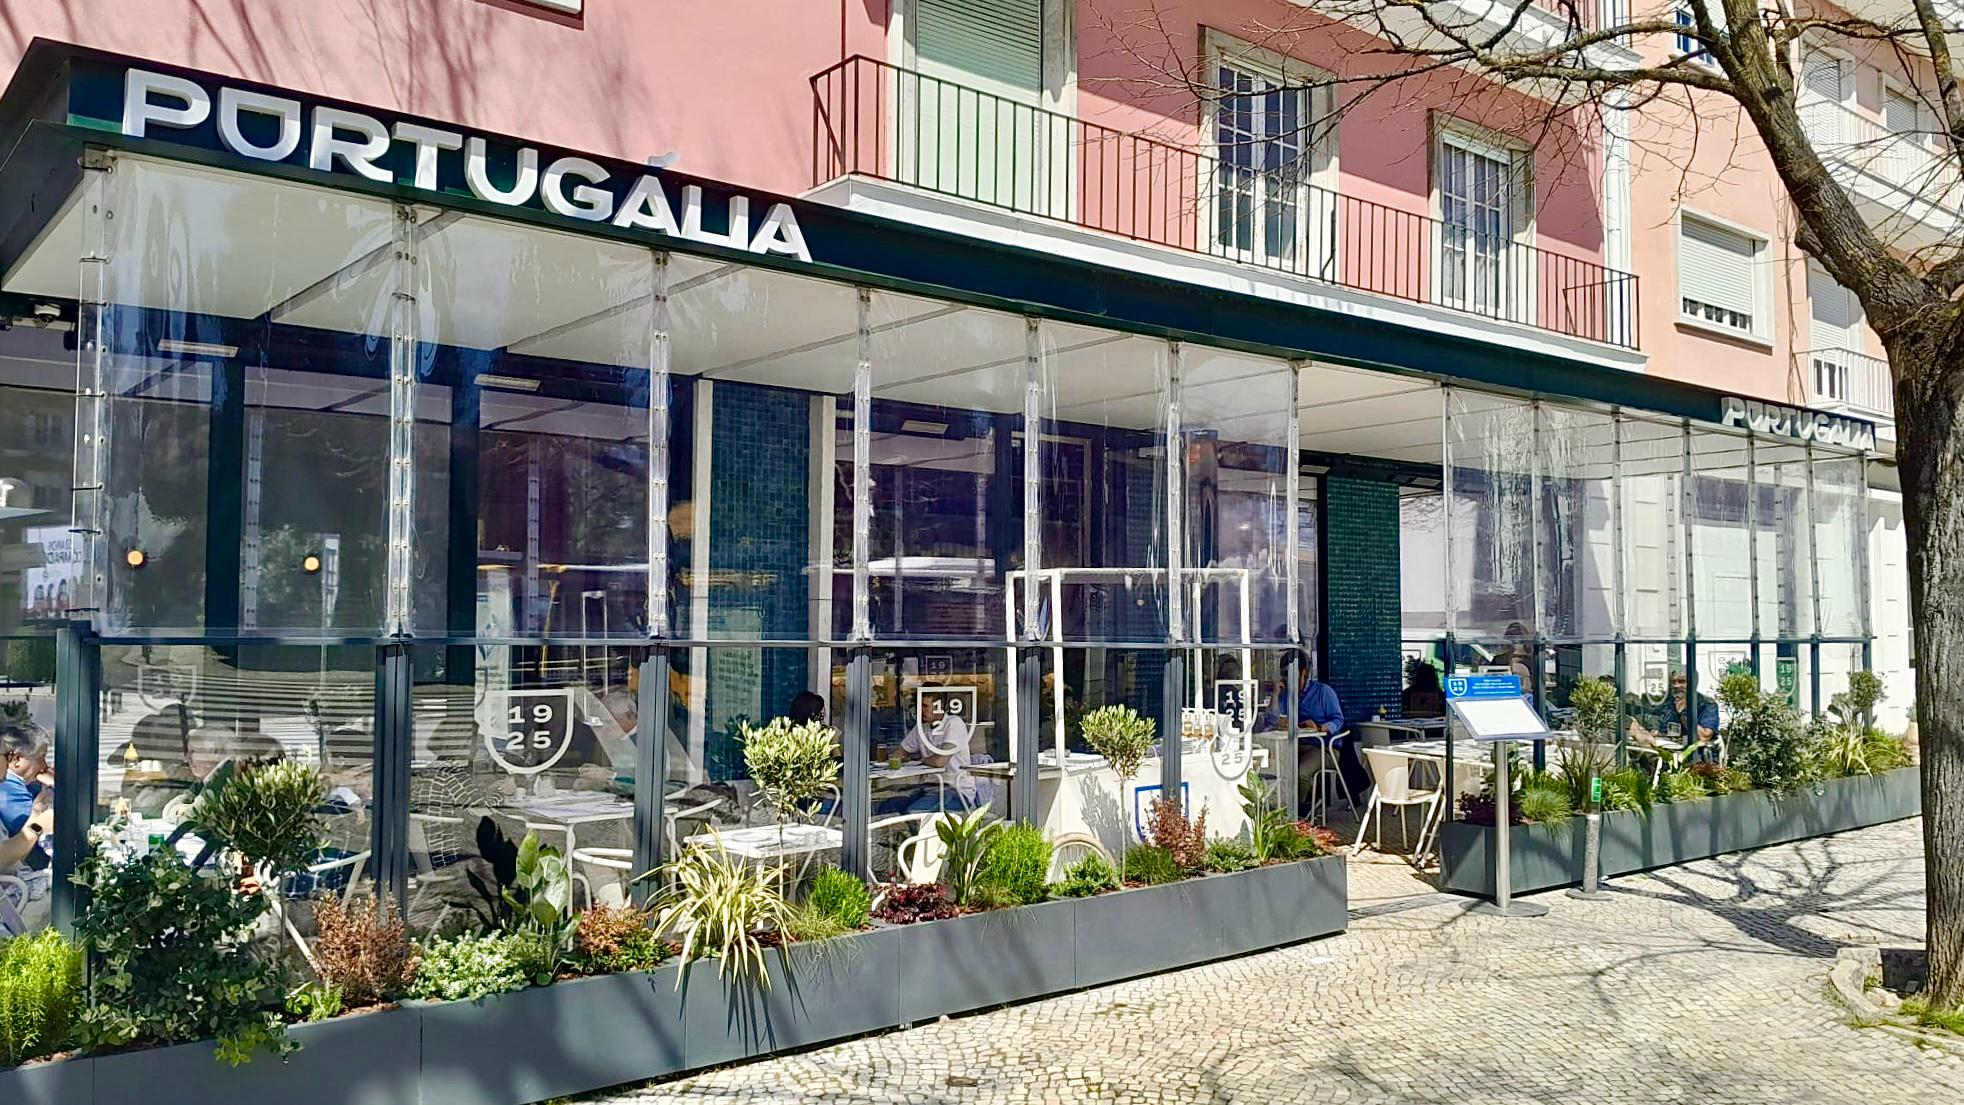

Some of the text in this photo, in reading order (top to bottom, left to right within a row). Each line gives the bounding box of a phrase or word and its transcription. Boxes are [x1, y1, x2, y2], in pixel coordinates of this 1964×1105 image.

[122, 68, 813, 264] PORTUGÁLIA
[1779, 664, 1792, 674] 19
[1779, 677, 1793, 687] 25
[508, 704, 553, 724] 19
[932, 698, 963, 714] 19
[506, 730, 551, 750] 25
[1221, 752, 1243, 766] 25
